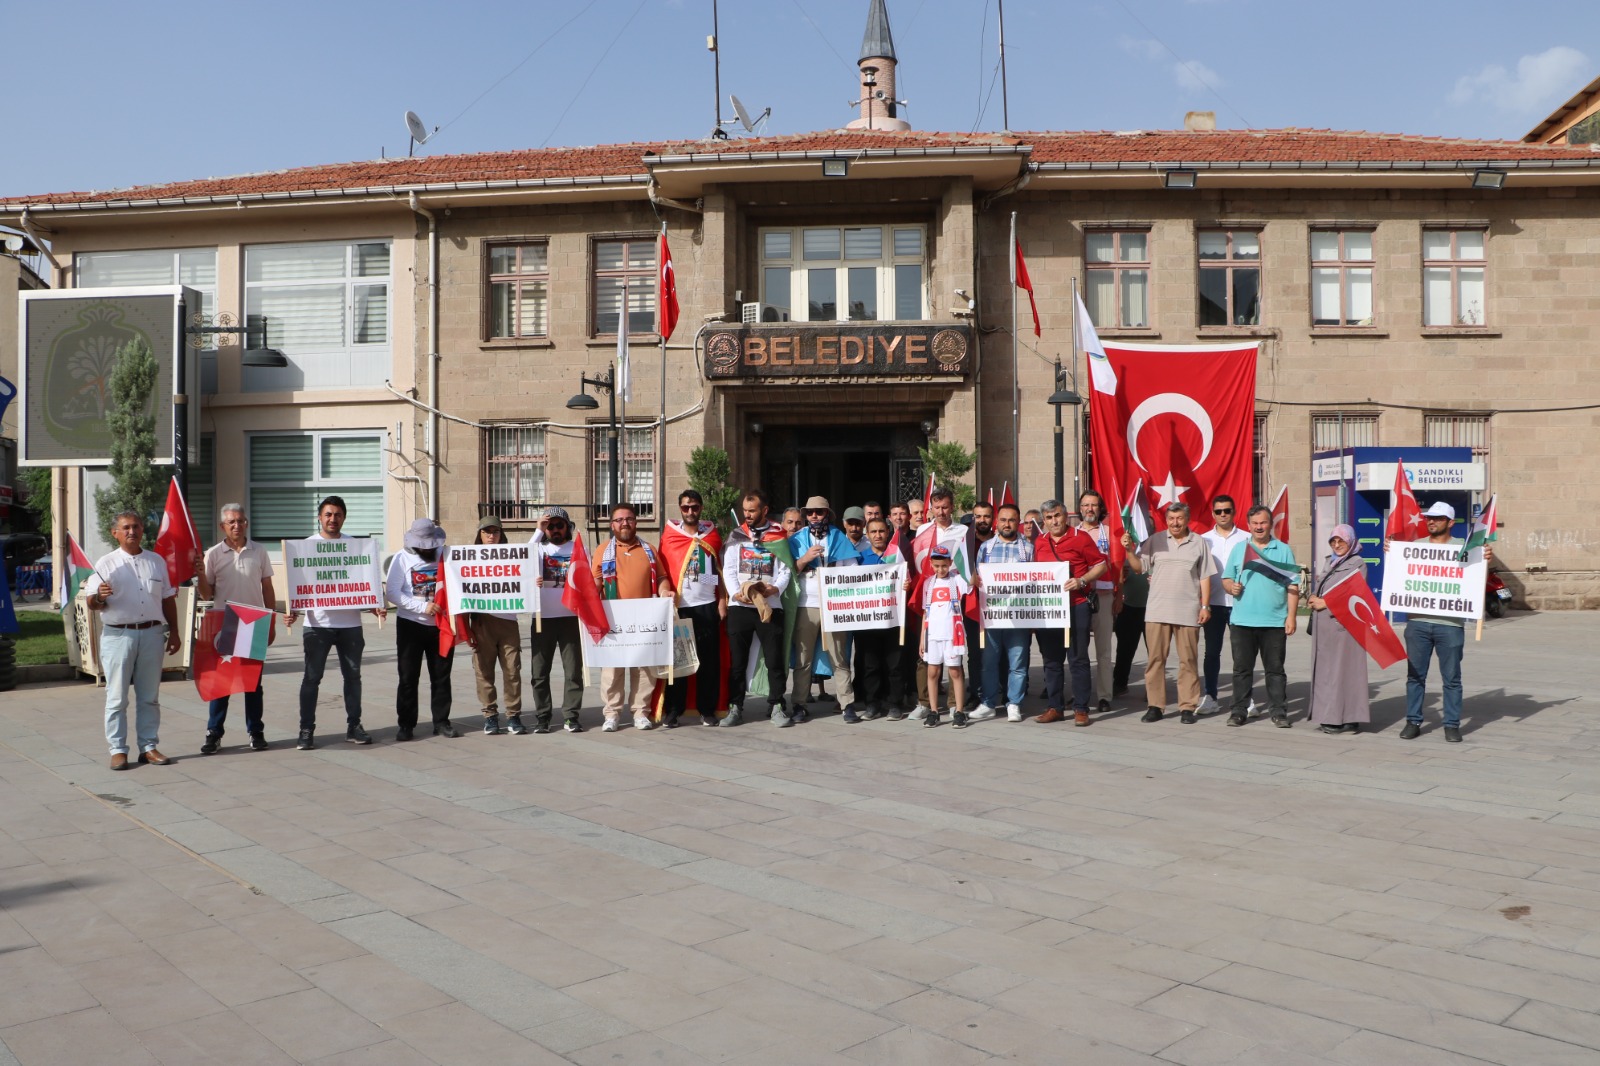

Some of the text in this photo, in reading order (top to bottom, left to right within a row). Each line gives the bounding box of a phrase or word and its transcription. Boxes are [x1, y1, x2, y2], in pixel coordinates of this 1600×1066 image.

[939, 364, 960, 372] 1869
[316, 542, 347, 553] ÜZÜLME
[452, 547, 528, 560] BİR SABAH
[293, 554, 371, 567] BU DAVANIN SAHİBİ
[1403, 547, 1468, 562] ÇOCUKLAR
[316, 570, 350, 580] HAK'TIR.
[460, 565, 521, 577] GELECEK
[993, 571, 1055, 581] YIKILSIN İSRAİL
[1408, 564, 1463, 578] UYURKEN
[825, 575, 836, 584] Bir
[838, 573, 873, 584] Olamadık
[874, 572, 883, 580] Ya
[296, 582, 371, 595] HAK OLAN DAVADA
[462, 582, 520, 594] KARDAN
[828, 586, 854, 598] Üflesin
[856, 587, 874, 596] sura
[987, 583, 1061, 594] ENKAZINI GÖREYİM
[1404, 580, 1460, 595] SUSULUR
[291, 595, 379, 609] ZAFER MUHAKKAKTIR.
[460, 598, 525, 610] AYDINLIK
[827, 600, 854, 611] Ümmet
[856, 600, 880, 610] uyanır
[986, 596, 1062, 607] SANA ÜLKE DİYENİN
[1390, 593, 1473, 612] ÖLÜNCE DEĞİL
[833, 614, 855, 623] Helak
[856, 612, 871, 621] olur
[984, 609, 1013, 620] YÜZÜNE
[1015, 609, 1061, 620] TÜKÜREYİM
